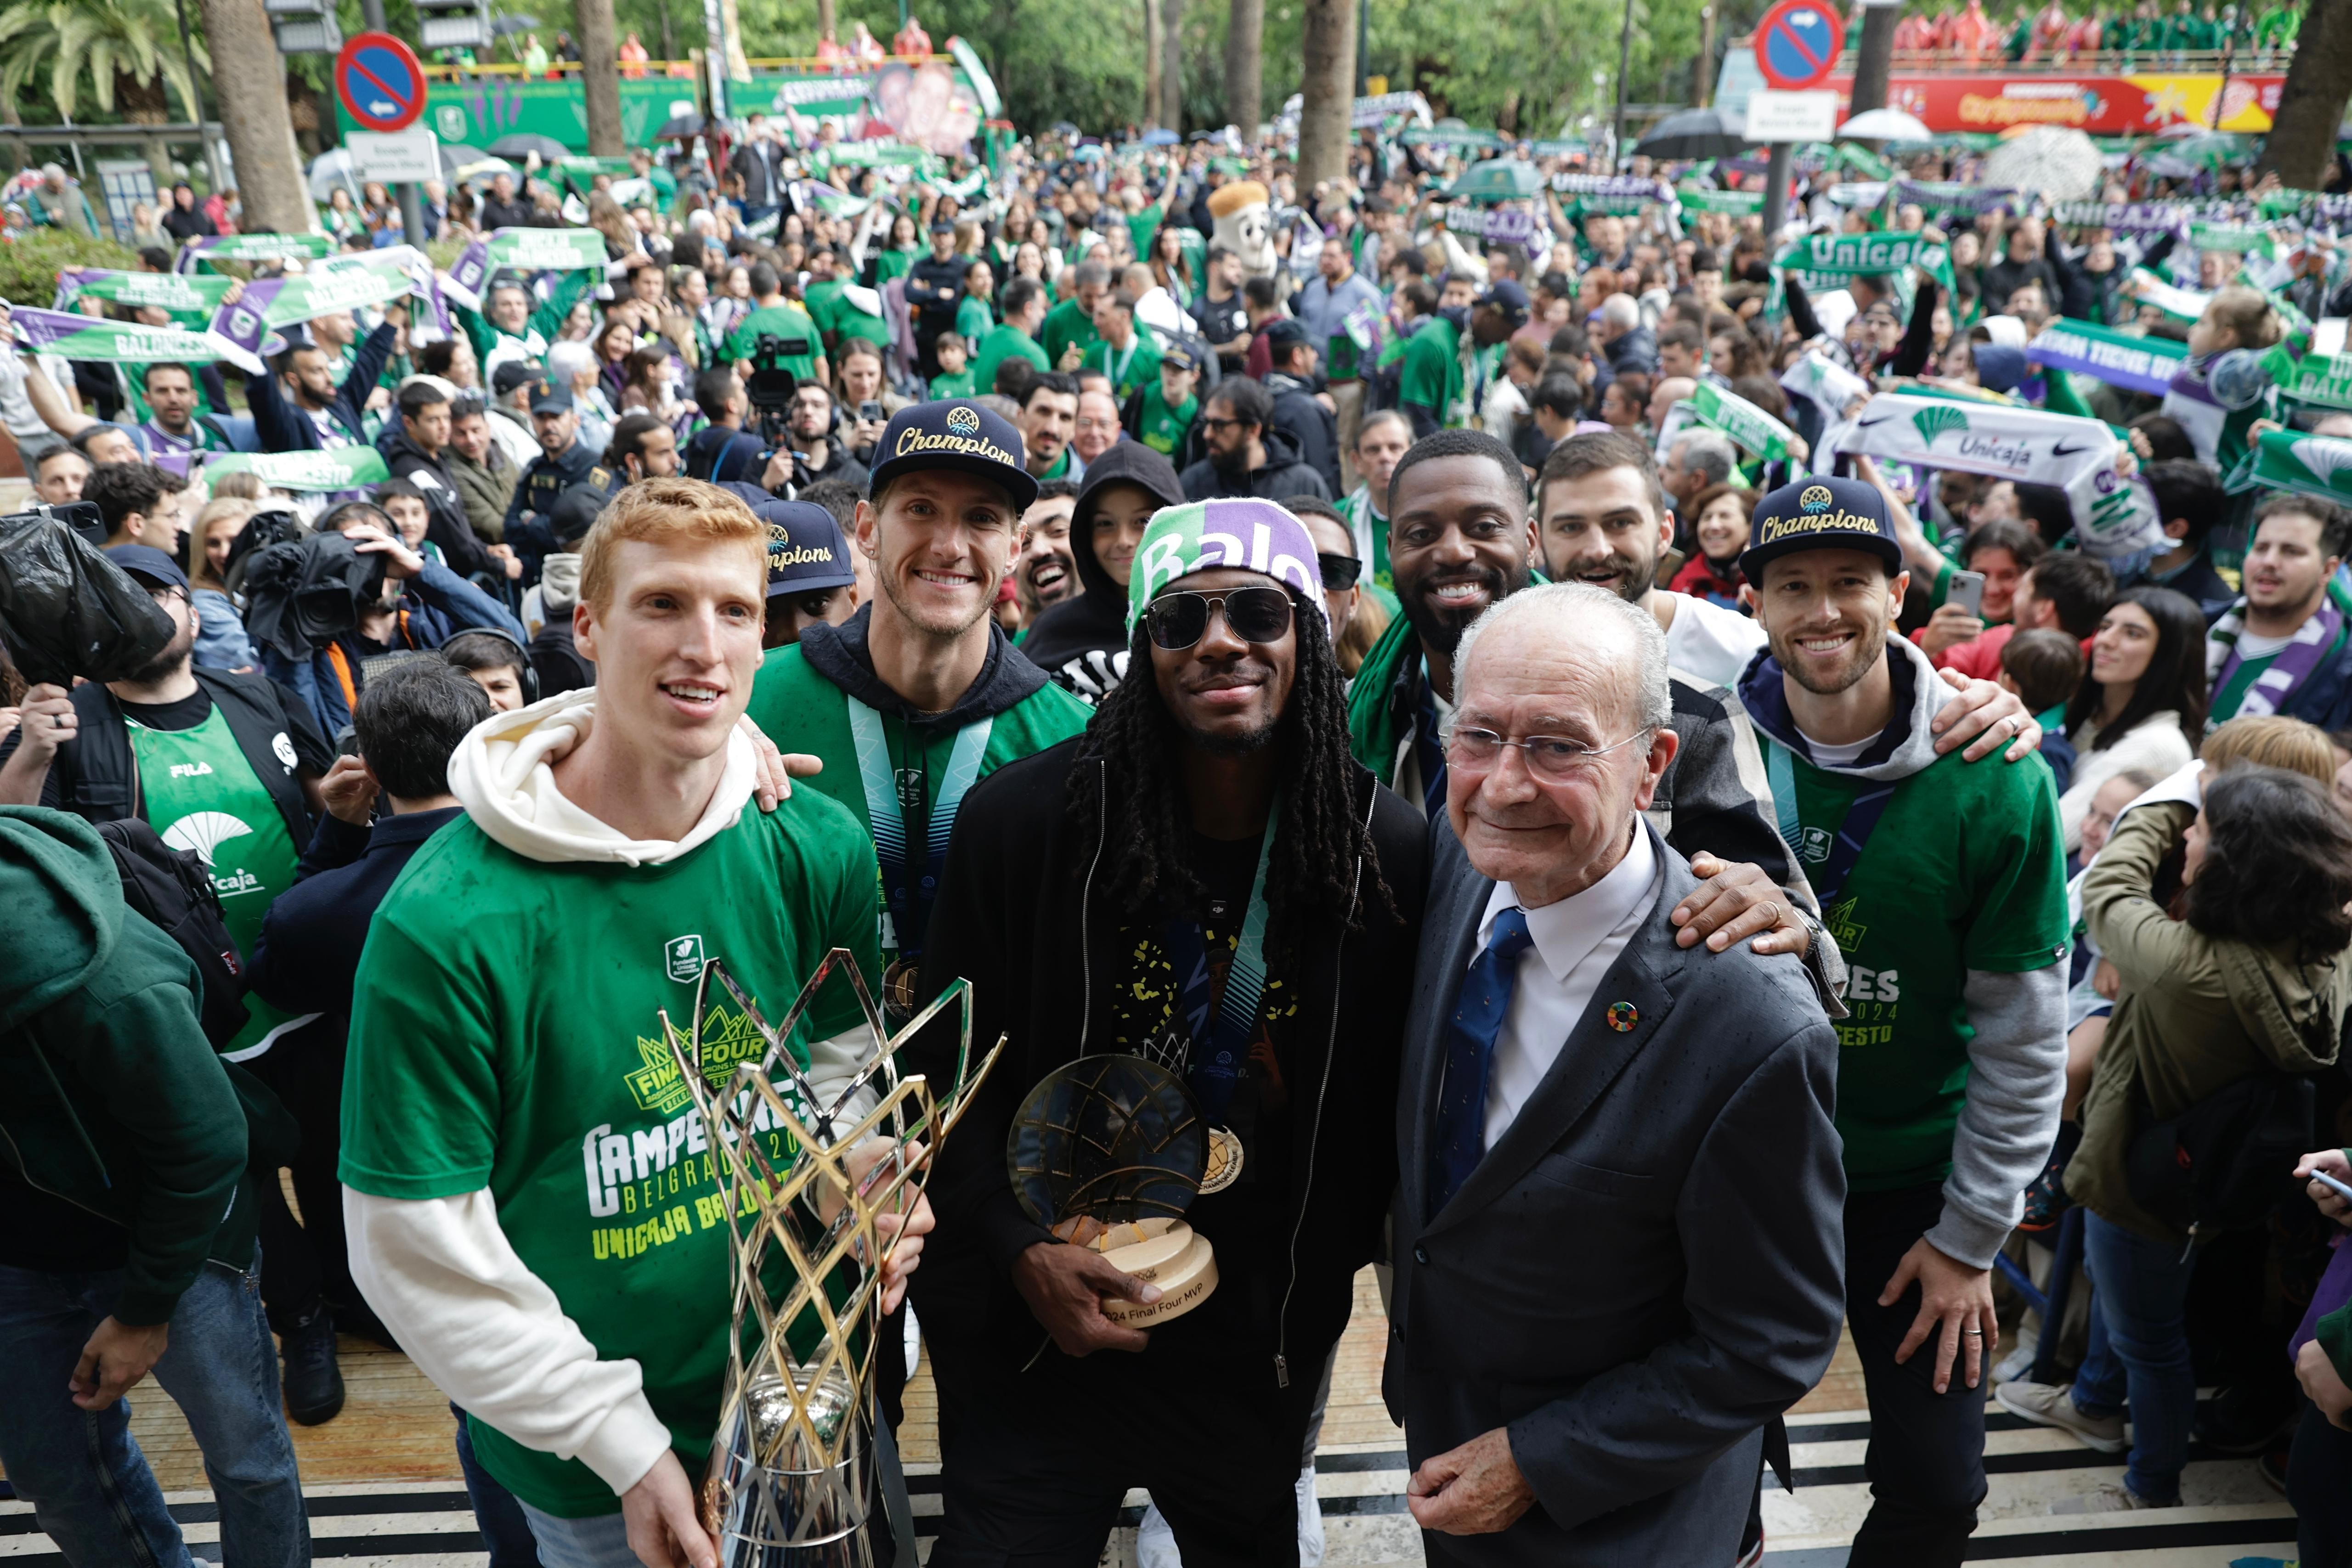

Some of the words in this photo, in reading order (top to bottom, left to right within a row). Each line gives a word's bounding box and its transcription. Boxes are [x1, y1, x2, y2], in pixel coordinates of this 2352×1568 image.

[896, 427, 1015, 467] Champions
[1960, 436, 2031, 468] Unicaja
[1761, 508, 1879, 544] Champions
[768, 545, 832, 572] mpions
[170, 761, 213, 779] FILA
[206, 868, 258, 891] icaja
[1836, 1025, 1893, 1046] CESTO
[636, 1059, 682, 1096] FINA
[701, 1038, 766, 1066] FOUR
[702, 1062, 729, 1075] PIONS
[667, 1091, 691, 1109] BELG
[1200, 1173, 1232, 1190] CHAMPIONS
[1230, 1149, 1238, 1173] LEAGUE
[592, 1205, 692, 1260] UNICAJA
[1104, 1311, 1126, 1321] 024
[1129, 1306, 1156, 1320] Final
[1158, 1297, 1182, 1313] Four
[1184, 1282, 1203, 1302] MVP
